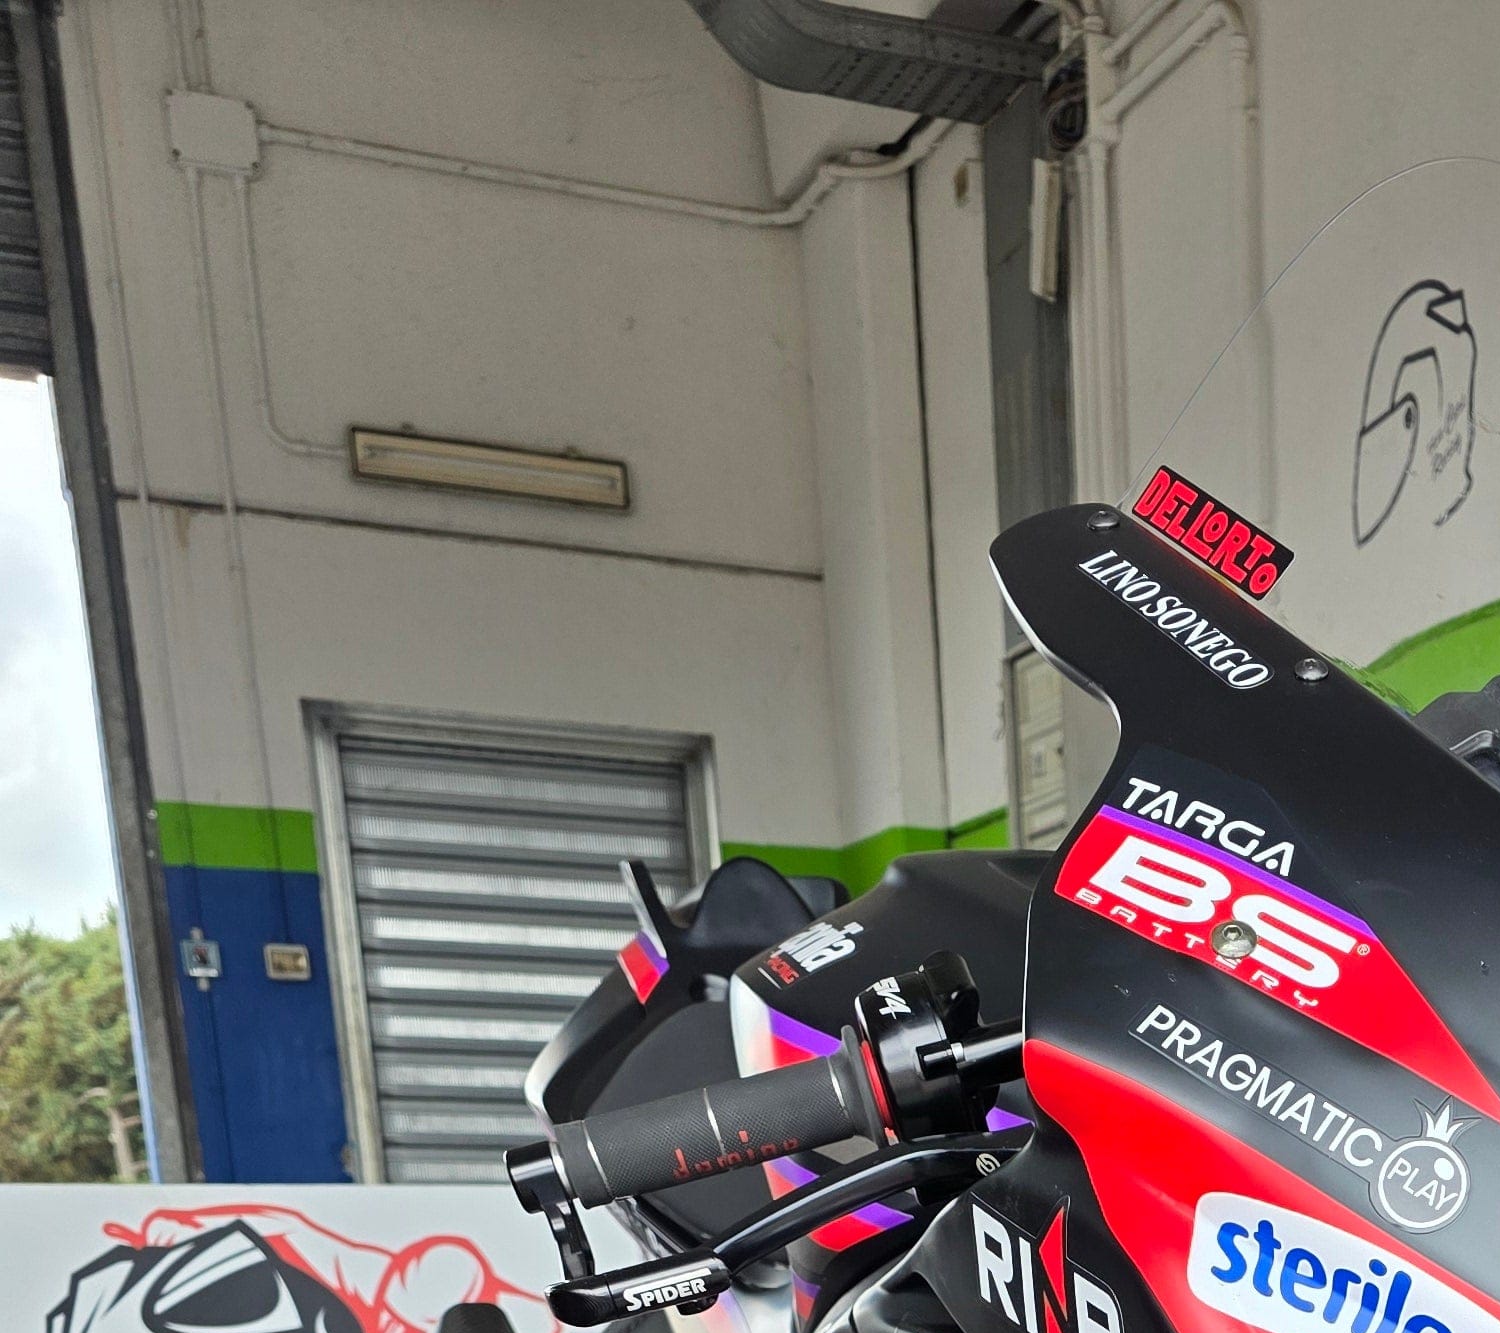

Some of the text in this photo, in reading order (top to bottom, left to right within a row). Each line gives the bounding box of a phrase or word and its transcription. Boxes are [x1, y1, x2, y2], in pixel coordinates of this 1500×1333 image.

[1132, 468, 1278, 595] DELLORTO
[1079, 549, 1272, 688] LINO SONEGO
[1122, 777, 1295, 877] TARGA
[1136, 1004, 1459, 1212] PRAGMATIC PLAY
[623, 1267, 712, 1312] SPIDER
